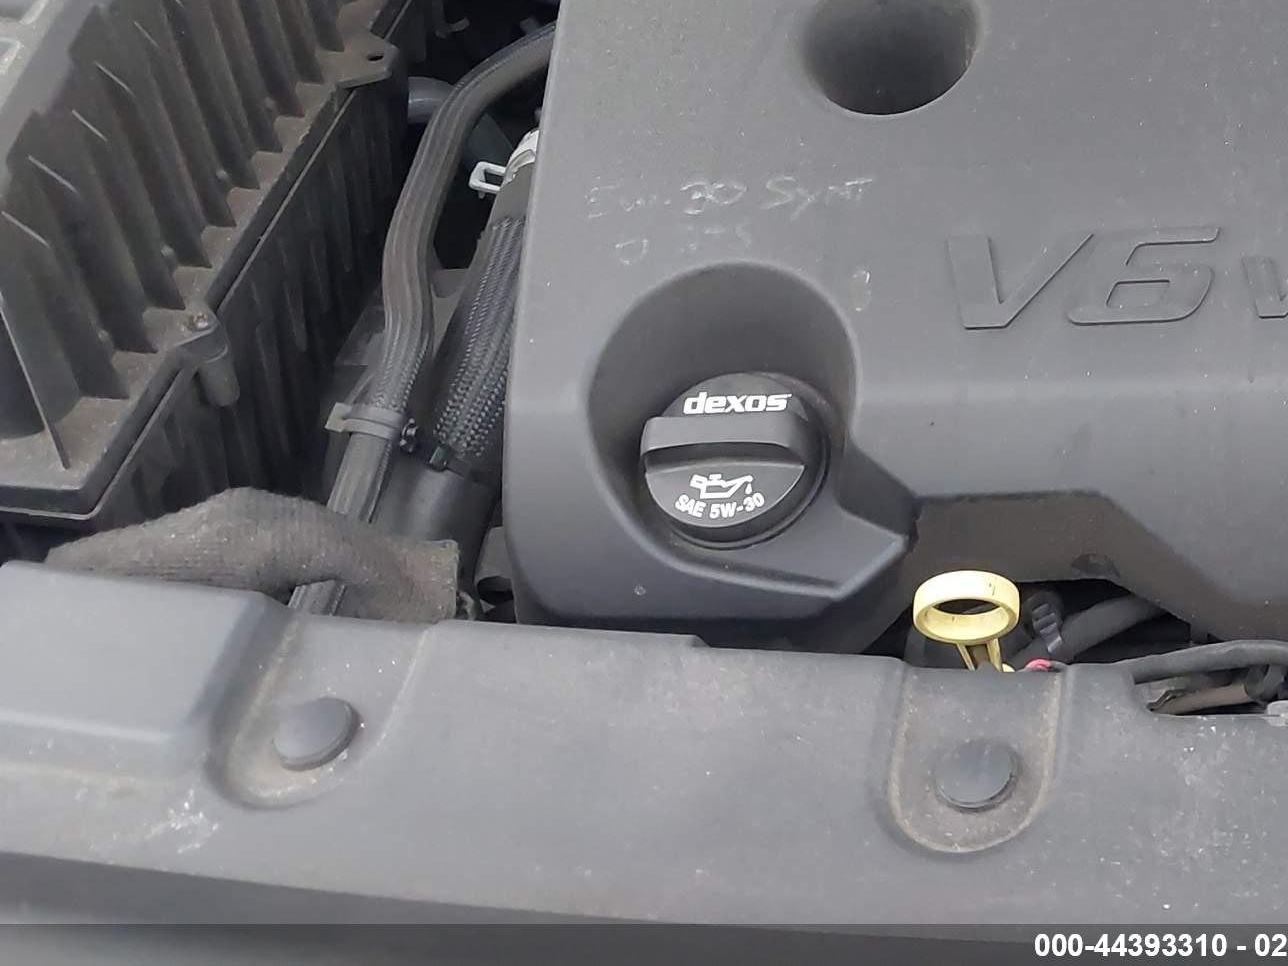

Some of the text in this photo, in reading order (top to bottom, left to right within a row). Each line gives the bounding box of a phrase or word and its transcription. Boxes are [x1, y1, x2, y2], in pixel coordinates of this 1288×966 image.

[947, 225, 1221, 330] V6
[684, 392, 791, 414] dexos
[675, 492, 766, 519] SAE 5W-30
